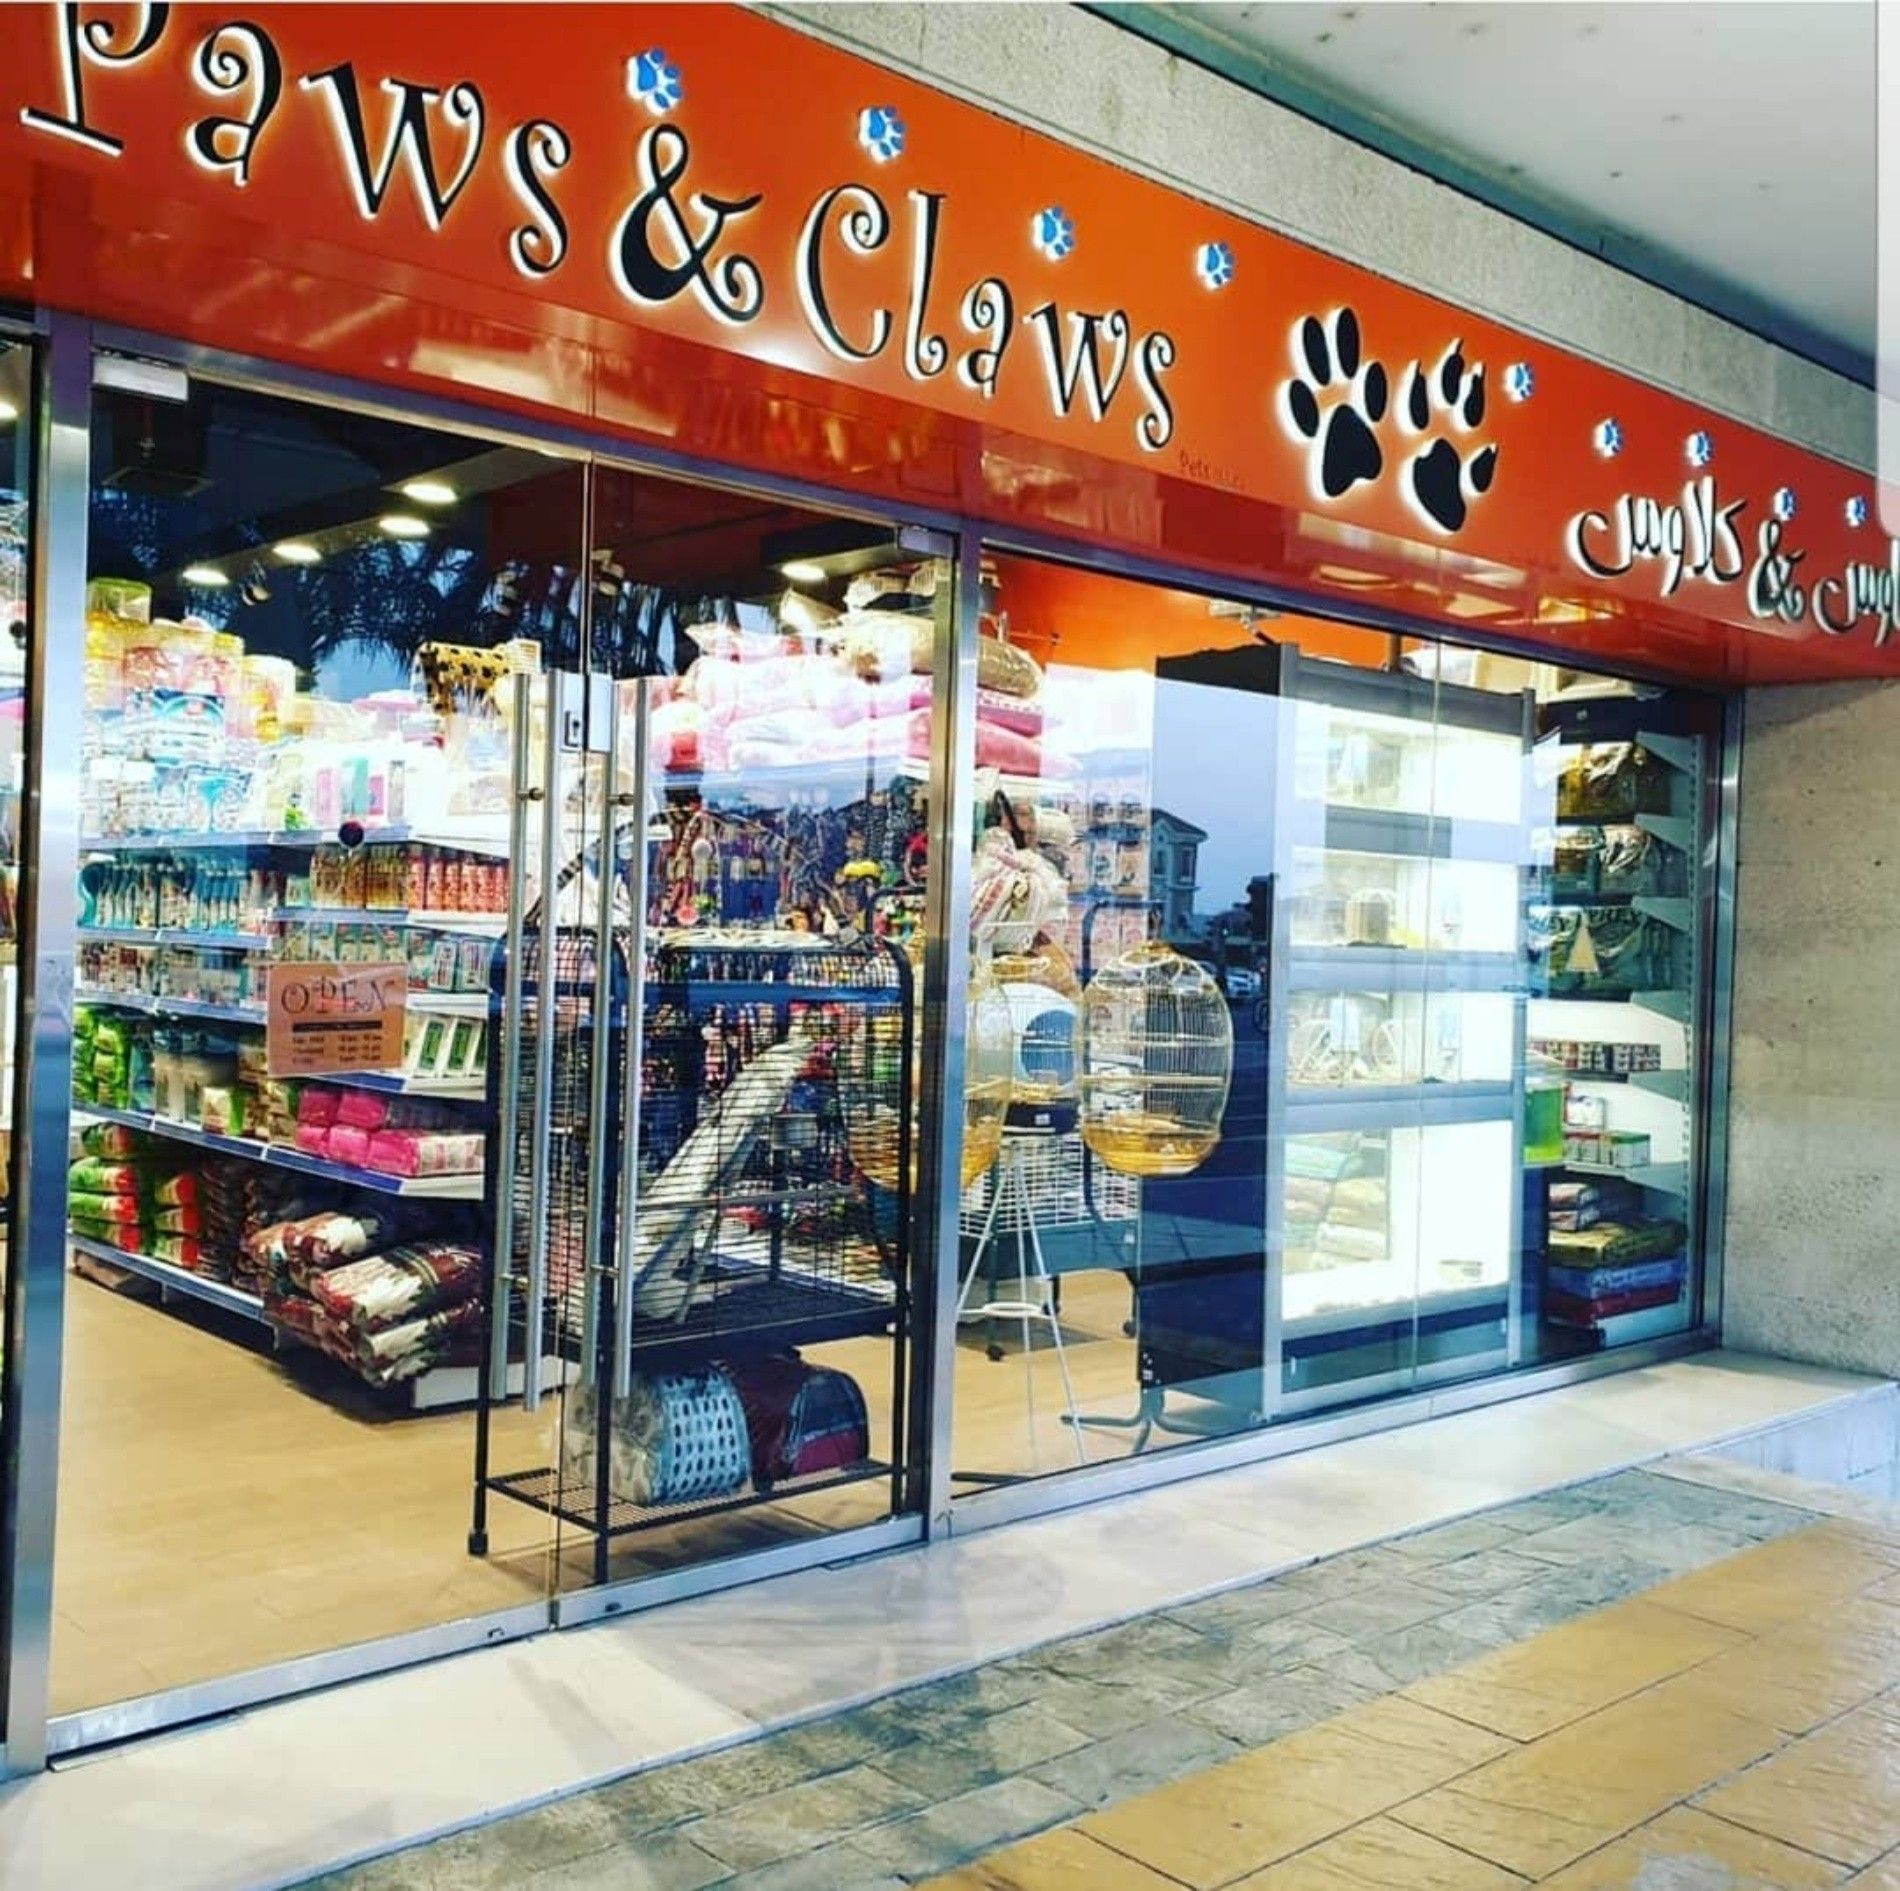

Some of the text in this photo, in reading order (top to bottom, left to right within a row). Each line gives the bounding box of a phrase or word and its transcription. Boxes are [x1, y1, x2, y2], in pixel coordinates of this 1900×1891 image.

[20, 3, 1177, 452] Paws & Claws
[1564, 475, 1747, 597] كلاوس
[1749, 519, 1805, 623] &
[281, 976, 396, 1014] OPEN
